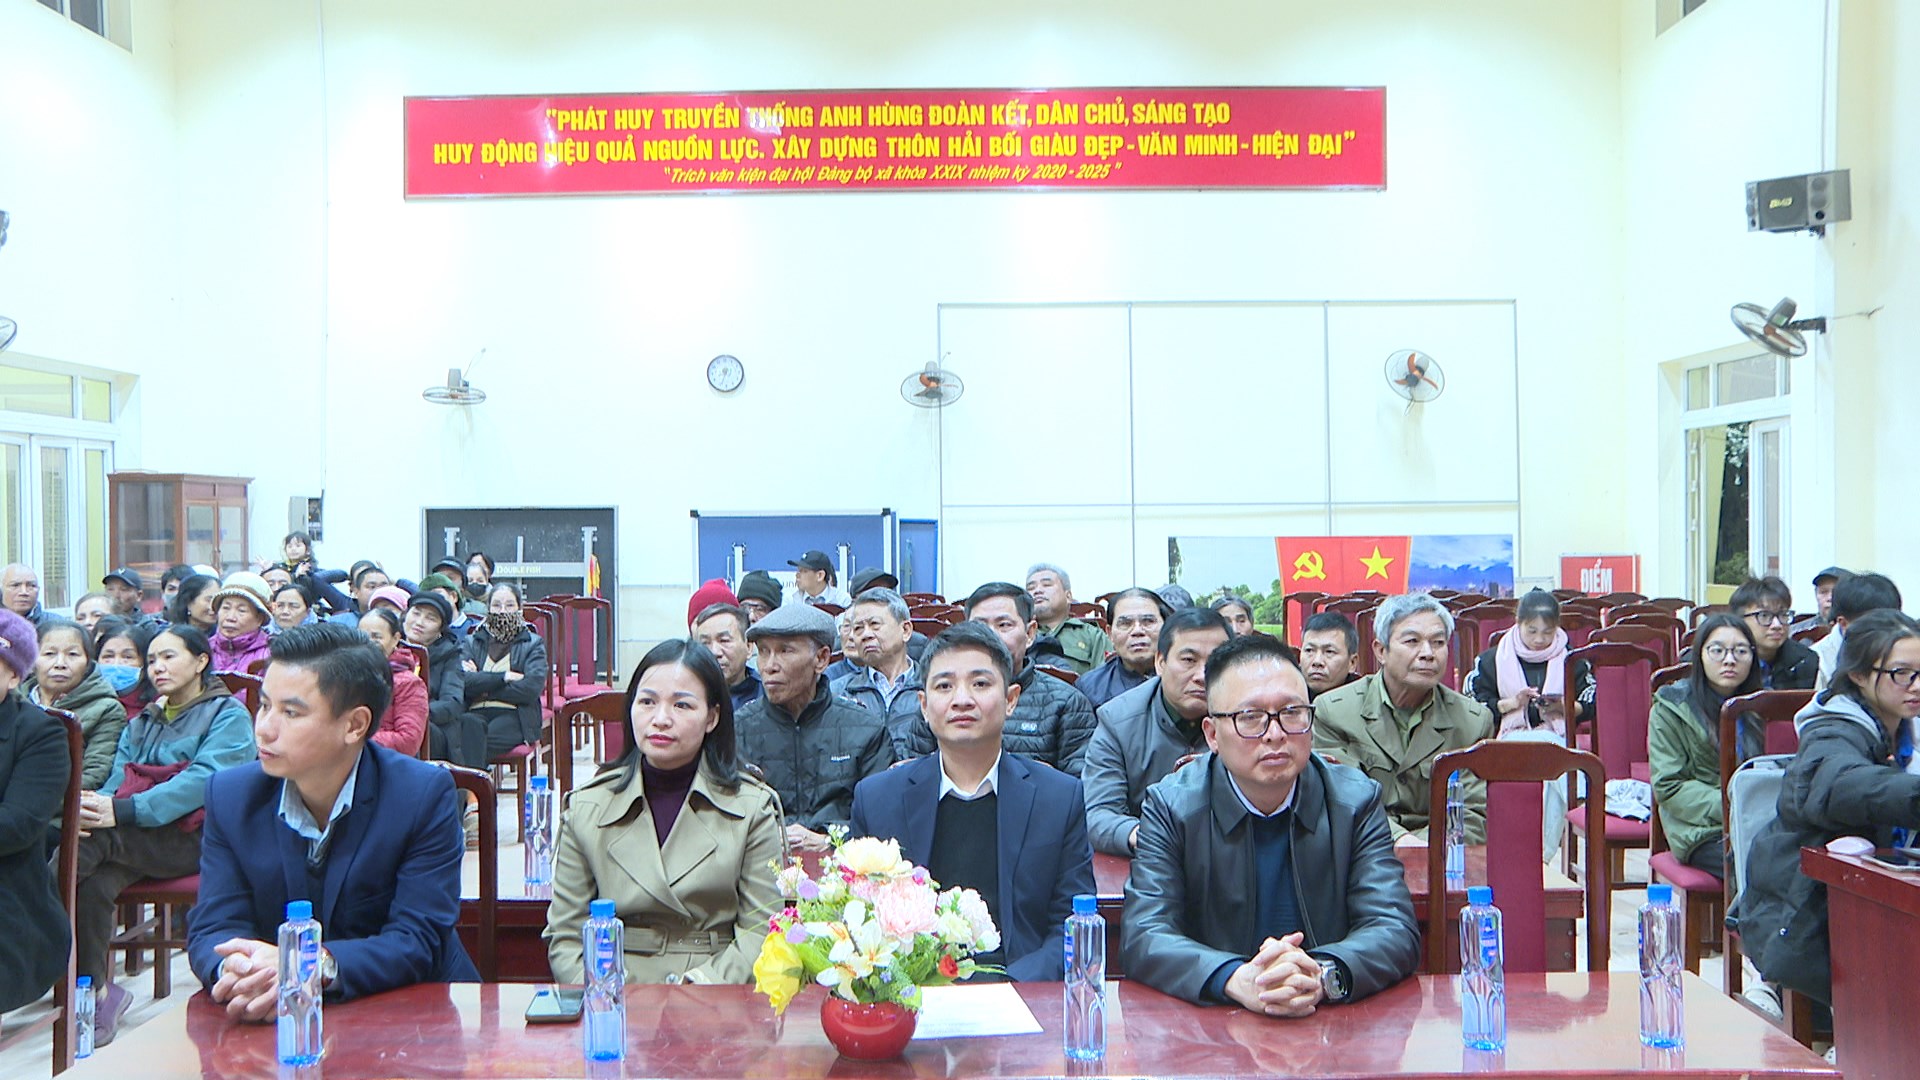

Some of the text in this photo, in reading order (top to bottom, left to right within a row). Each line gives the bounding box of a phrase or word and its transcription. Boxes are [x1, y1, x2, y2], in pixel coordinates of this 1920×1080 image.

[614, 109, 654, 130] HUY
[662, 102, 740, 130] TRUYỀN
[746, 101, 814, 128] THỐNG
[820, 105, 863, 127] ANH
[868, 101, 924, 126] HÙNG
[929, 100, 986, 126] ĐOÀN
[1036, 99, 1079, 125] DÂN
[1084, 96, 1130, 127] CHỦ,
[1132, 99, 1187, 125] SÁNG
[1193, 102, 1231, 128] TẠO
[433, 143, 474, 165] HUY
[481, 138, 538, 167] ĐỘNG
[544, 137, 590, 166] HIỆU
[596, 134, 637, 164] QUẢ
[643, 134, 713, 162] NGUỒN
[772, 134, 812, 160] XÂY
[819, 136, 878, 162] DỰNG
[886, 132, 940, 159] THÔN
[948, 130, 982, 157] HẢI
[989, 130, 1022, 157] BỐI
[1030, 132, 1078, 157] GIÀU
[709, 168, 735, 183] văn
[737, 167, 767, 184] kiện
[768, 166, 792, 184] đại
[791, 166, 816, 184] hội
[817, 166, 854, 184] Đảng
[854, 165, 875, 184] bộ
[874, 166, 895, 181] xã
[893, 165, 928, 180] khóa
[929, 165, 968, 180] XXIX
[967, 164, 1012, 183] nhiệm
[1011, 164, 1032, 183] kỳ
[1031, 163, 1068, 179] 2020
[1580, 558, 1613, 594] ĐIỂM
